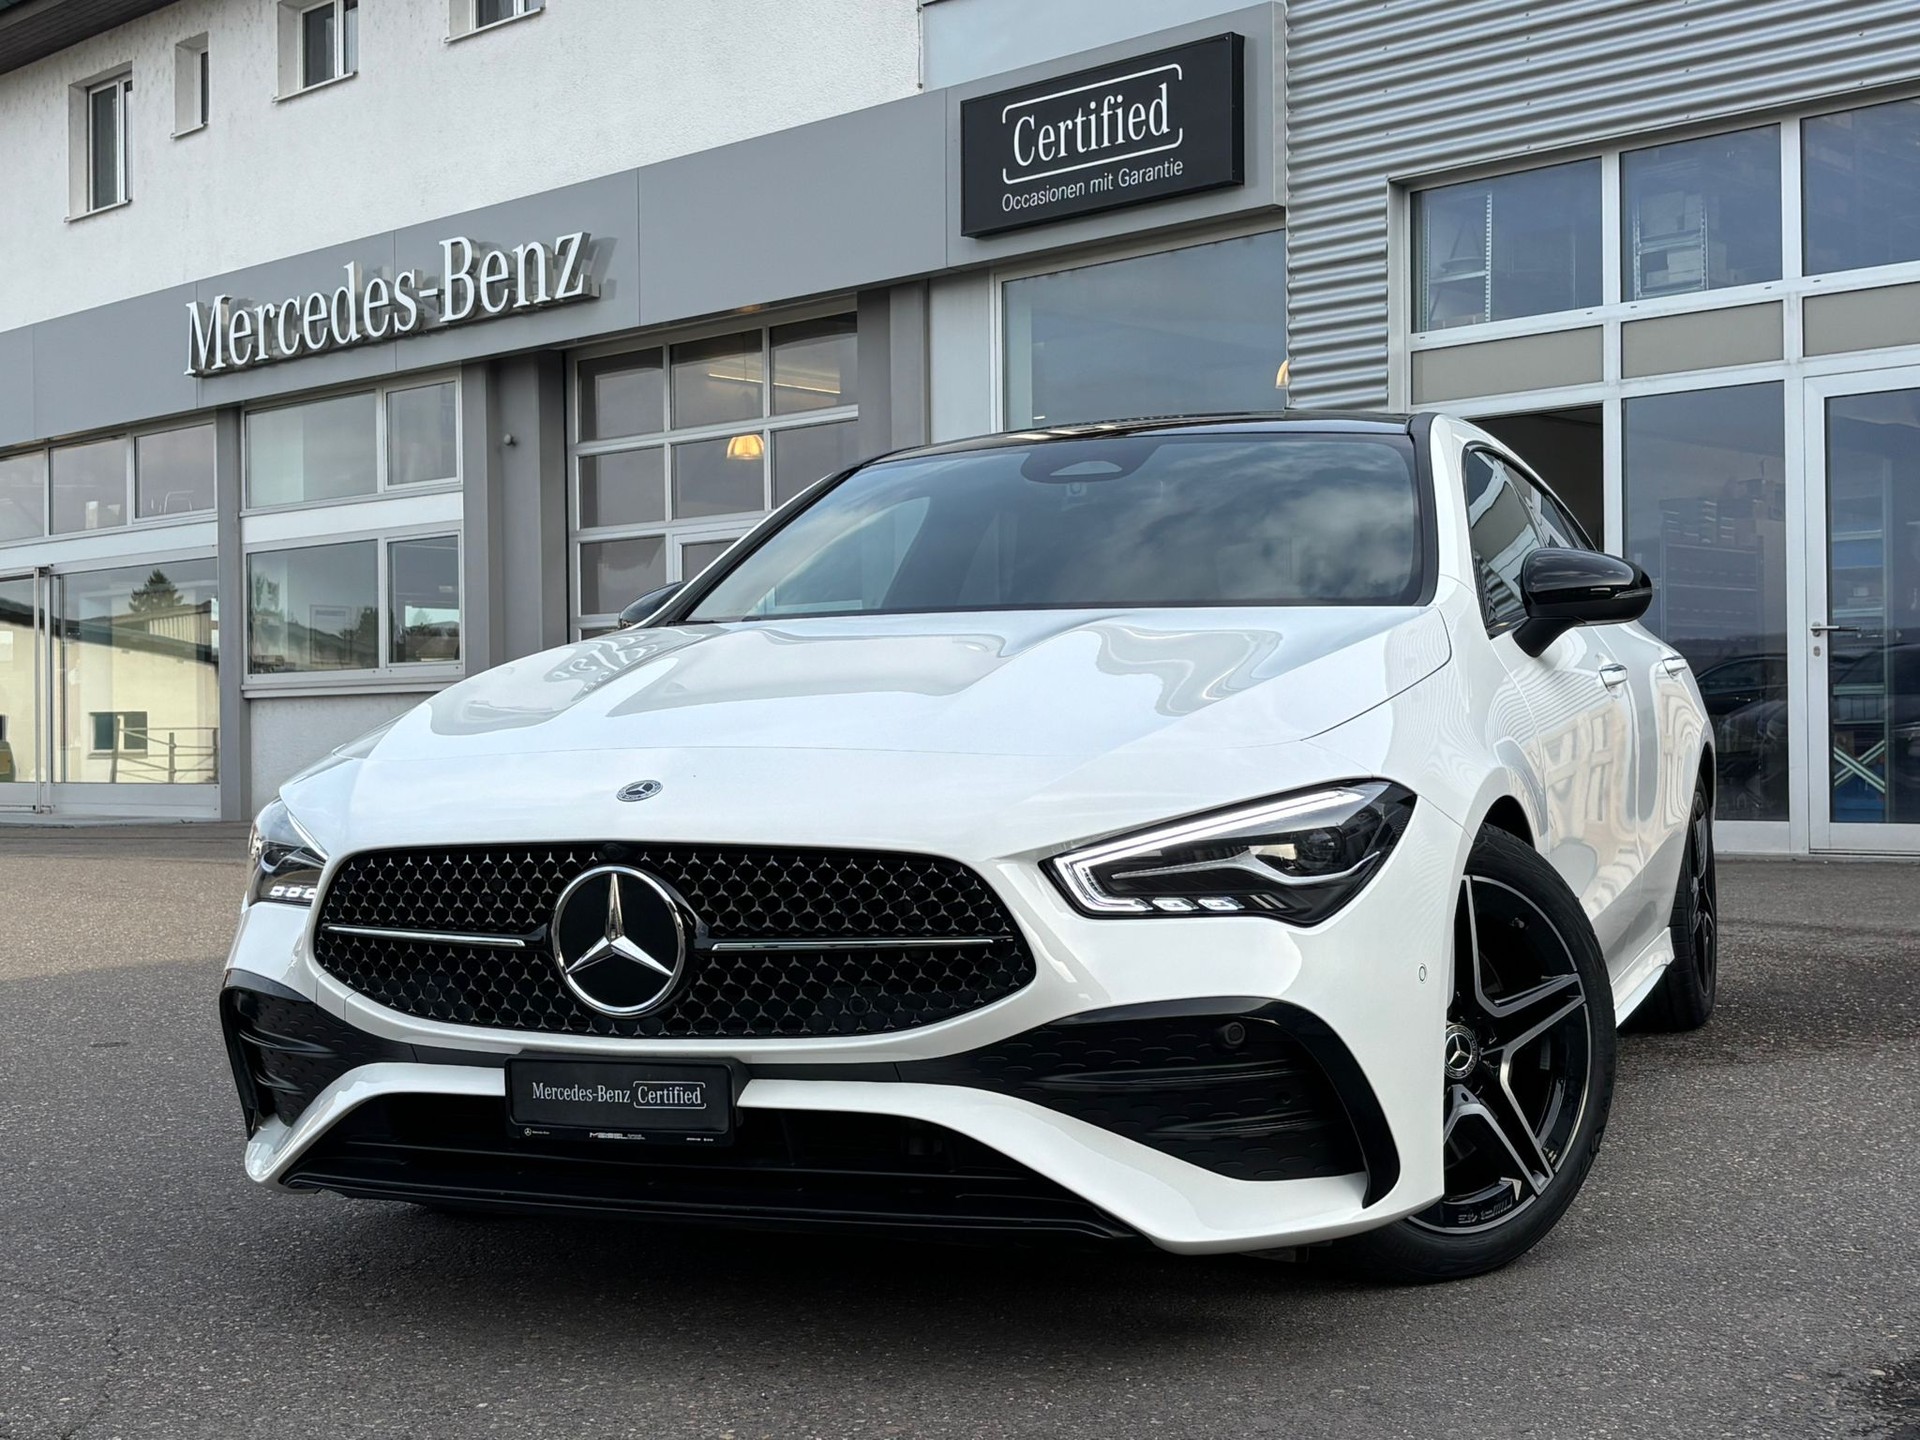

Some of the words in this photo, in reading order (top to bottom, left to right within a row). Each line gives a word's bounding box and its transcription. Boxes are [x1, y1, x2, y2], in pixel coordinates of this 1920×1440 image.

[1013, 82, 1170, 167] Certified
[1002, 181, 1084, 211] Occasionen
[1090, 172, 1114, 194] mit
[1118, 158, 1183, 187] Garantie
[184, 231, 590, 376] Mercedes-Benz
[532, 1082, 631, 1103] Mercedes-Benz
[638, 1085, 702, 1105] Certified
